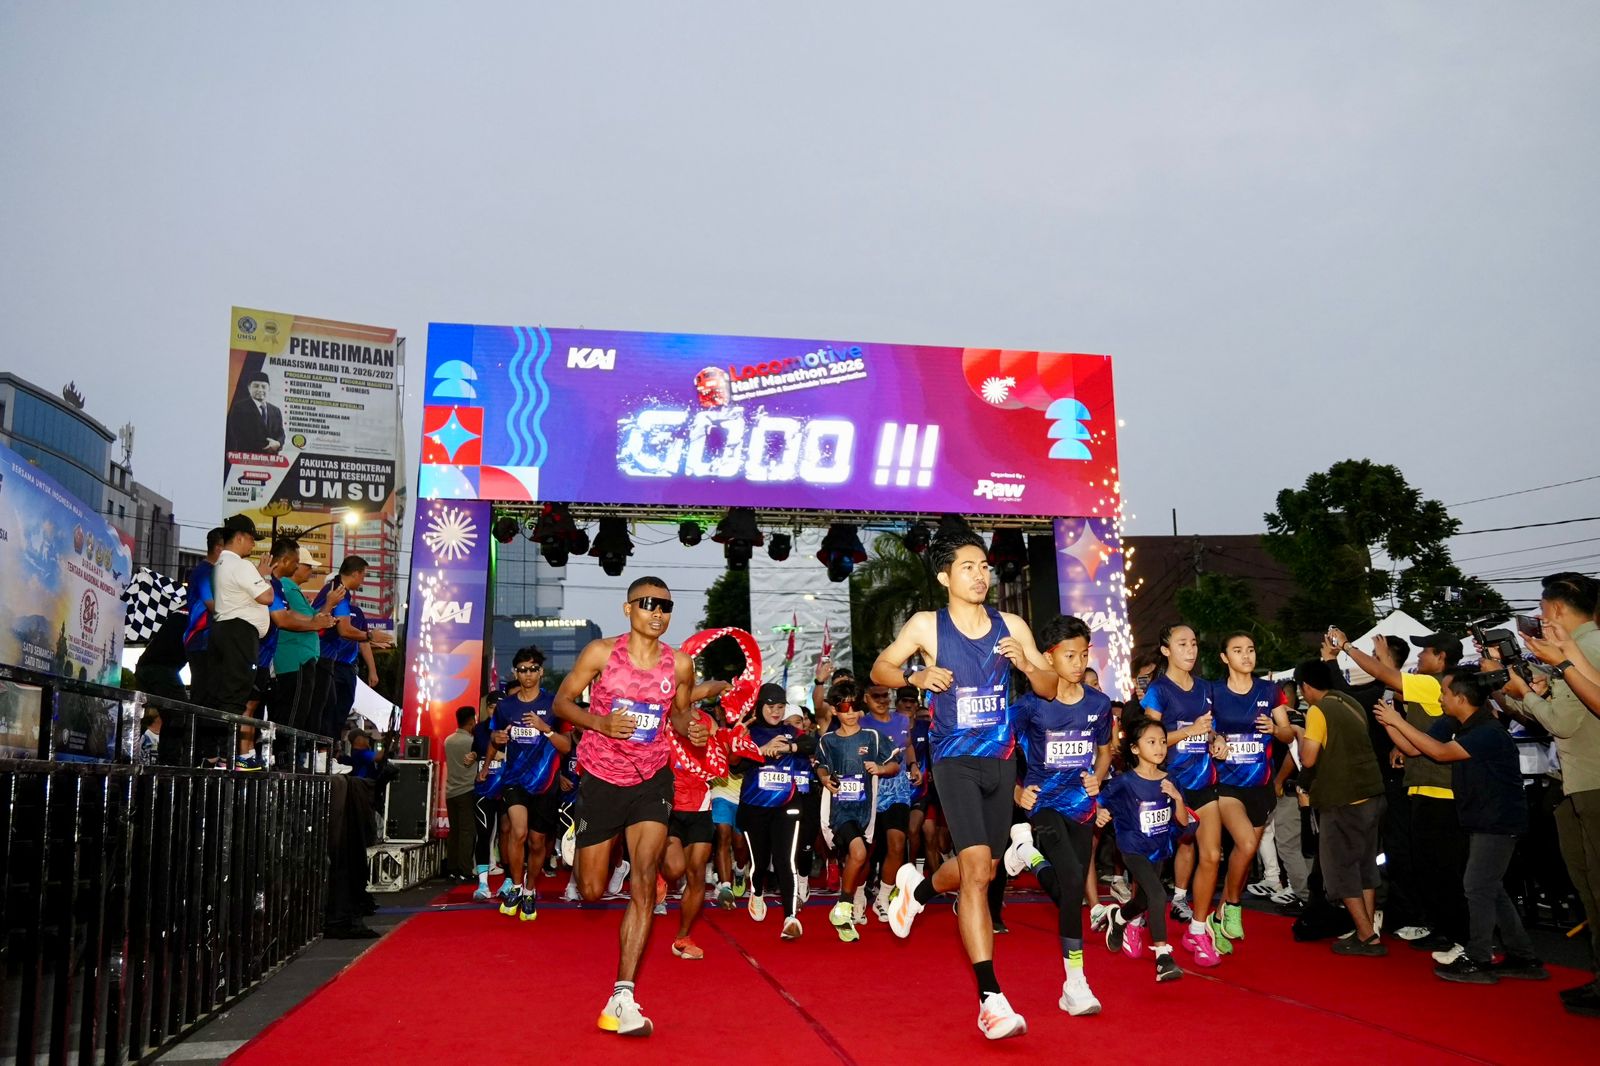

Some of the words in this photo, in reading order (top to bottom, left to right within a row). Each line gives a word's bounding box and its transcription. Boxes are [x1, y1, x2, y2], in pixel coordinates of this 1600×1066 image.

[290, 337, 394, 367] PENERIMAAN
[567, 347, 616, 370] KAI
[269, 357, 317, 370] MAHASISWA
[318, 362, 339, 374] BARU
[340, 365, 352, 375] TA.
[353, 366, 394, 380] 2026/2027
[728, 345, 862, 382] Locomotive
[286, 372, 311, 380] PROGRAM
[731, 376, 760, 393] Half
[762, 366, 828, 387] Marathon
[828, 358, 864, 376] 2026
[290, 380, 322, 390] KEDOKTERAN
[290, 388, 310, 396] PROFESI
[311, 390, 331, 398] DOKTER
[346, 386, 370, 395] BIOMEDIS
[616, 410, 855, 484] GOOO
[874, 421, 940, 487] !!!
[300, 458, 338, 470] FAKULTAS
[340, 461, 392, 474] KEDOKTERAN
[300, 468, 316, 478] DAN
[318, 470, 340, 480] ILMU
[340, 472, 386, 483] KESEHATAN
[300, 479, 385, 502] UMSU
[973, 480, 1026, 500] Raw
[68, 562, 82, 578] TENTARA
[421, 600, 472, 624] KAI
[514, 620, 544, 628] GRAND
[23, 642, 33, 653] SATU
[34, 644, 54, 658] SEMANGAT
[24, 655, 35, 666] SATU
[36, 658, 50, 671] TUJUAN
[514, 728, 532, 736] 51968
[1052, 742, 1083, 755] 51216
[1230, 743, 1256, 753] 51400
[762, 772, 785, 782] 51448
[1145, 808, 1168, 824] 51867
